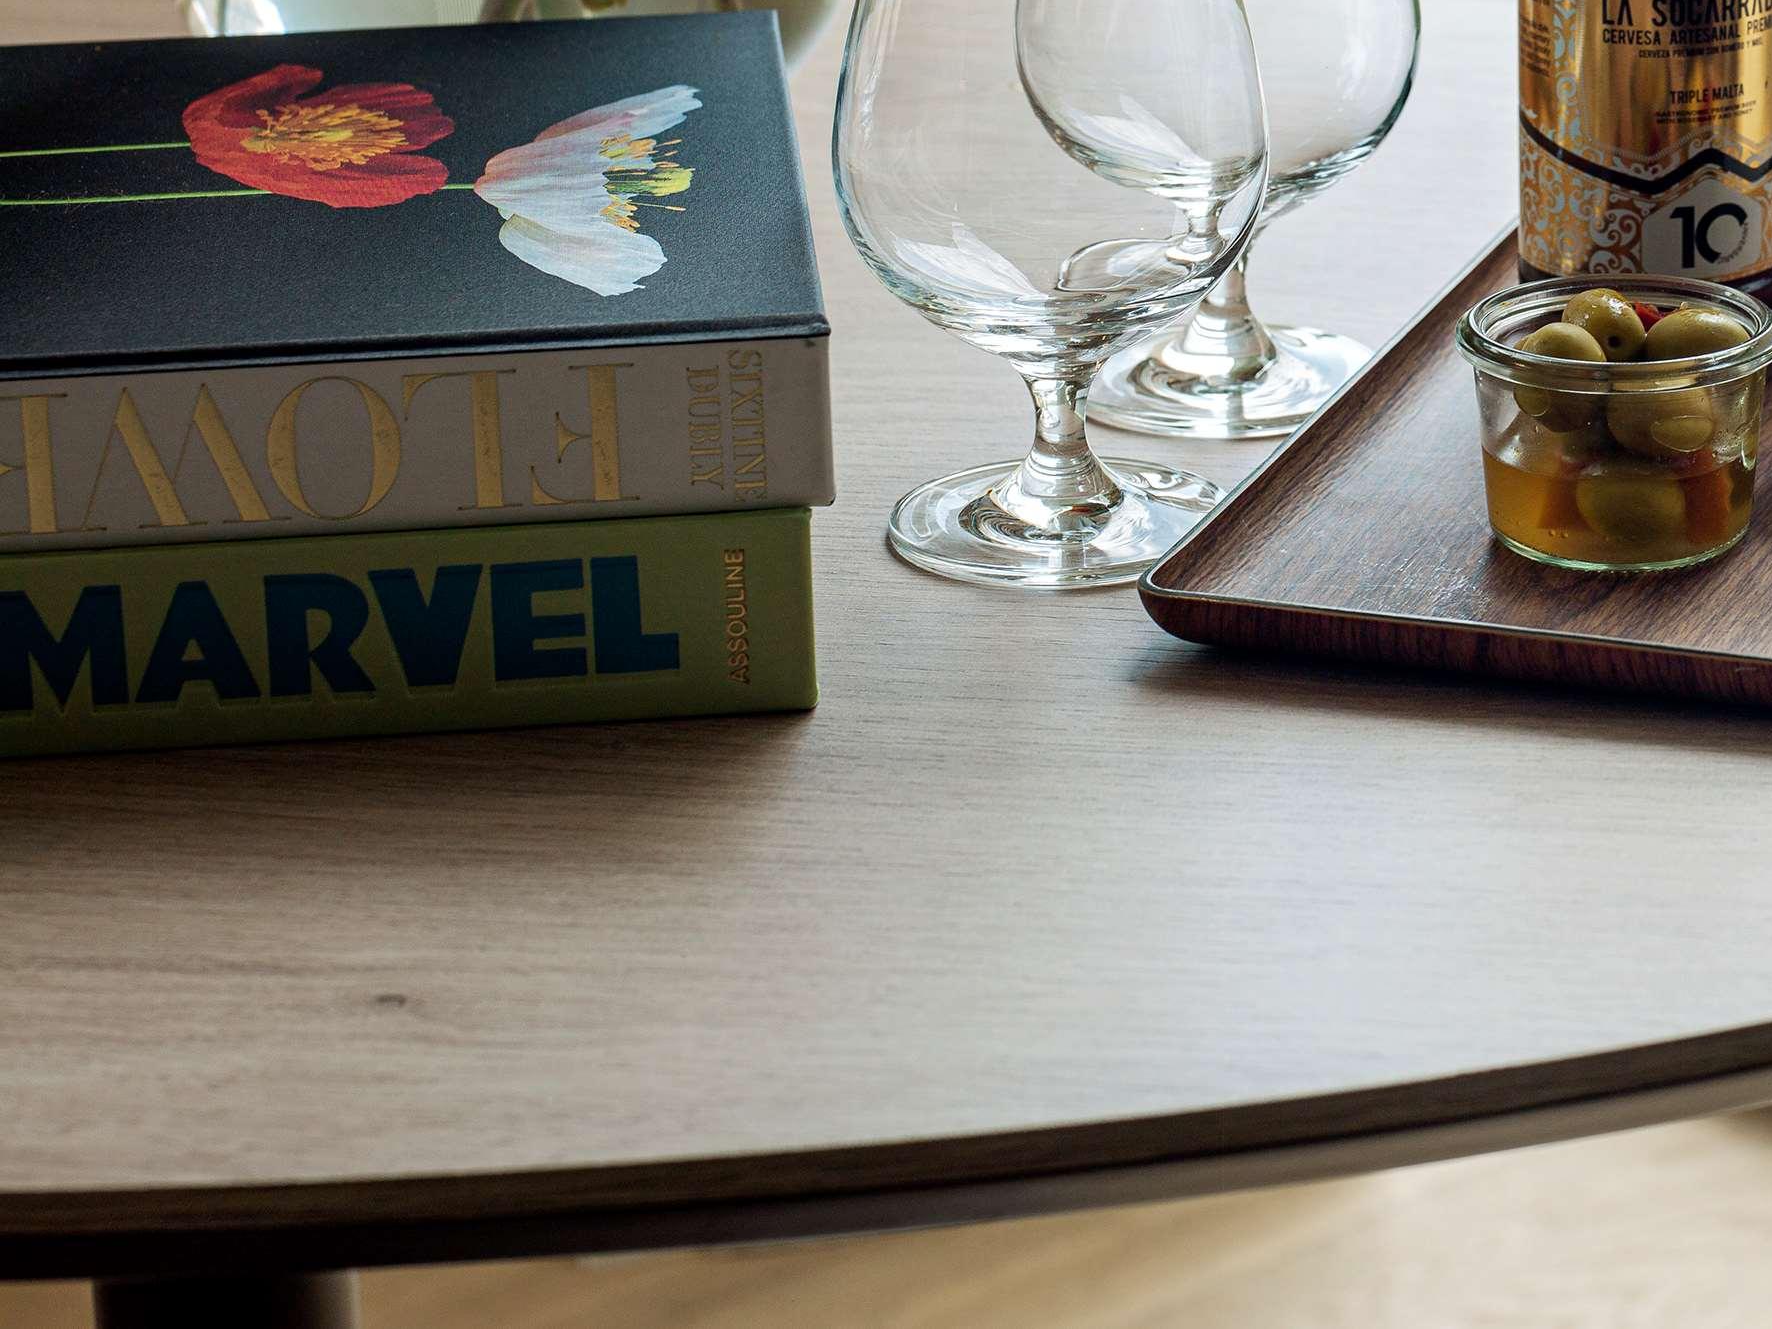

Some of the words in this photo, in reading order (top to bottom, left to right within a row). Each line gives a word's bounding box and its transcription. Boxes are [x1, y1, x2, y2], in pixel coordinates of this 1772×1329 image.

[1602, 28, 1662, 46] CERVESA
[1670, 21, 1741, 46] ARTESANAL
[1670, 88, 1710, 104] TRIPLE
[1712, 83, 1744, 101] MALTA
[1669, 202, 1749, 269] 10
[684, 365, 726, 490] DUBLY
[727, 347, 767, 503] SIXTINE
[0, 553, 681, 713] MARVEL
[723, 547, 752, 686] ASSOULINE
